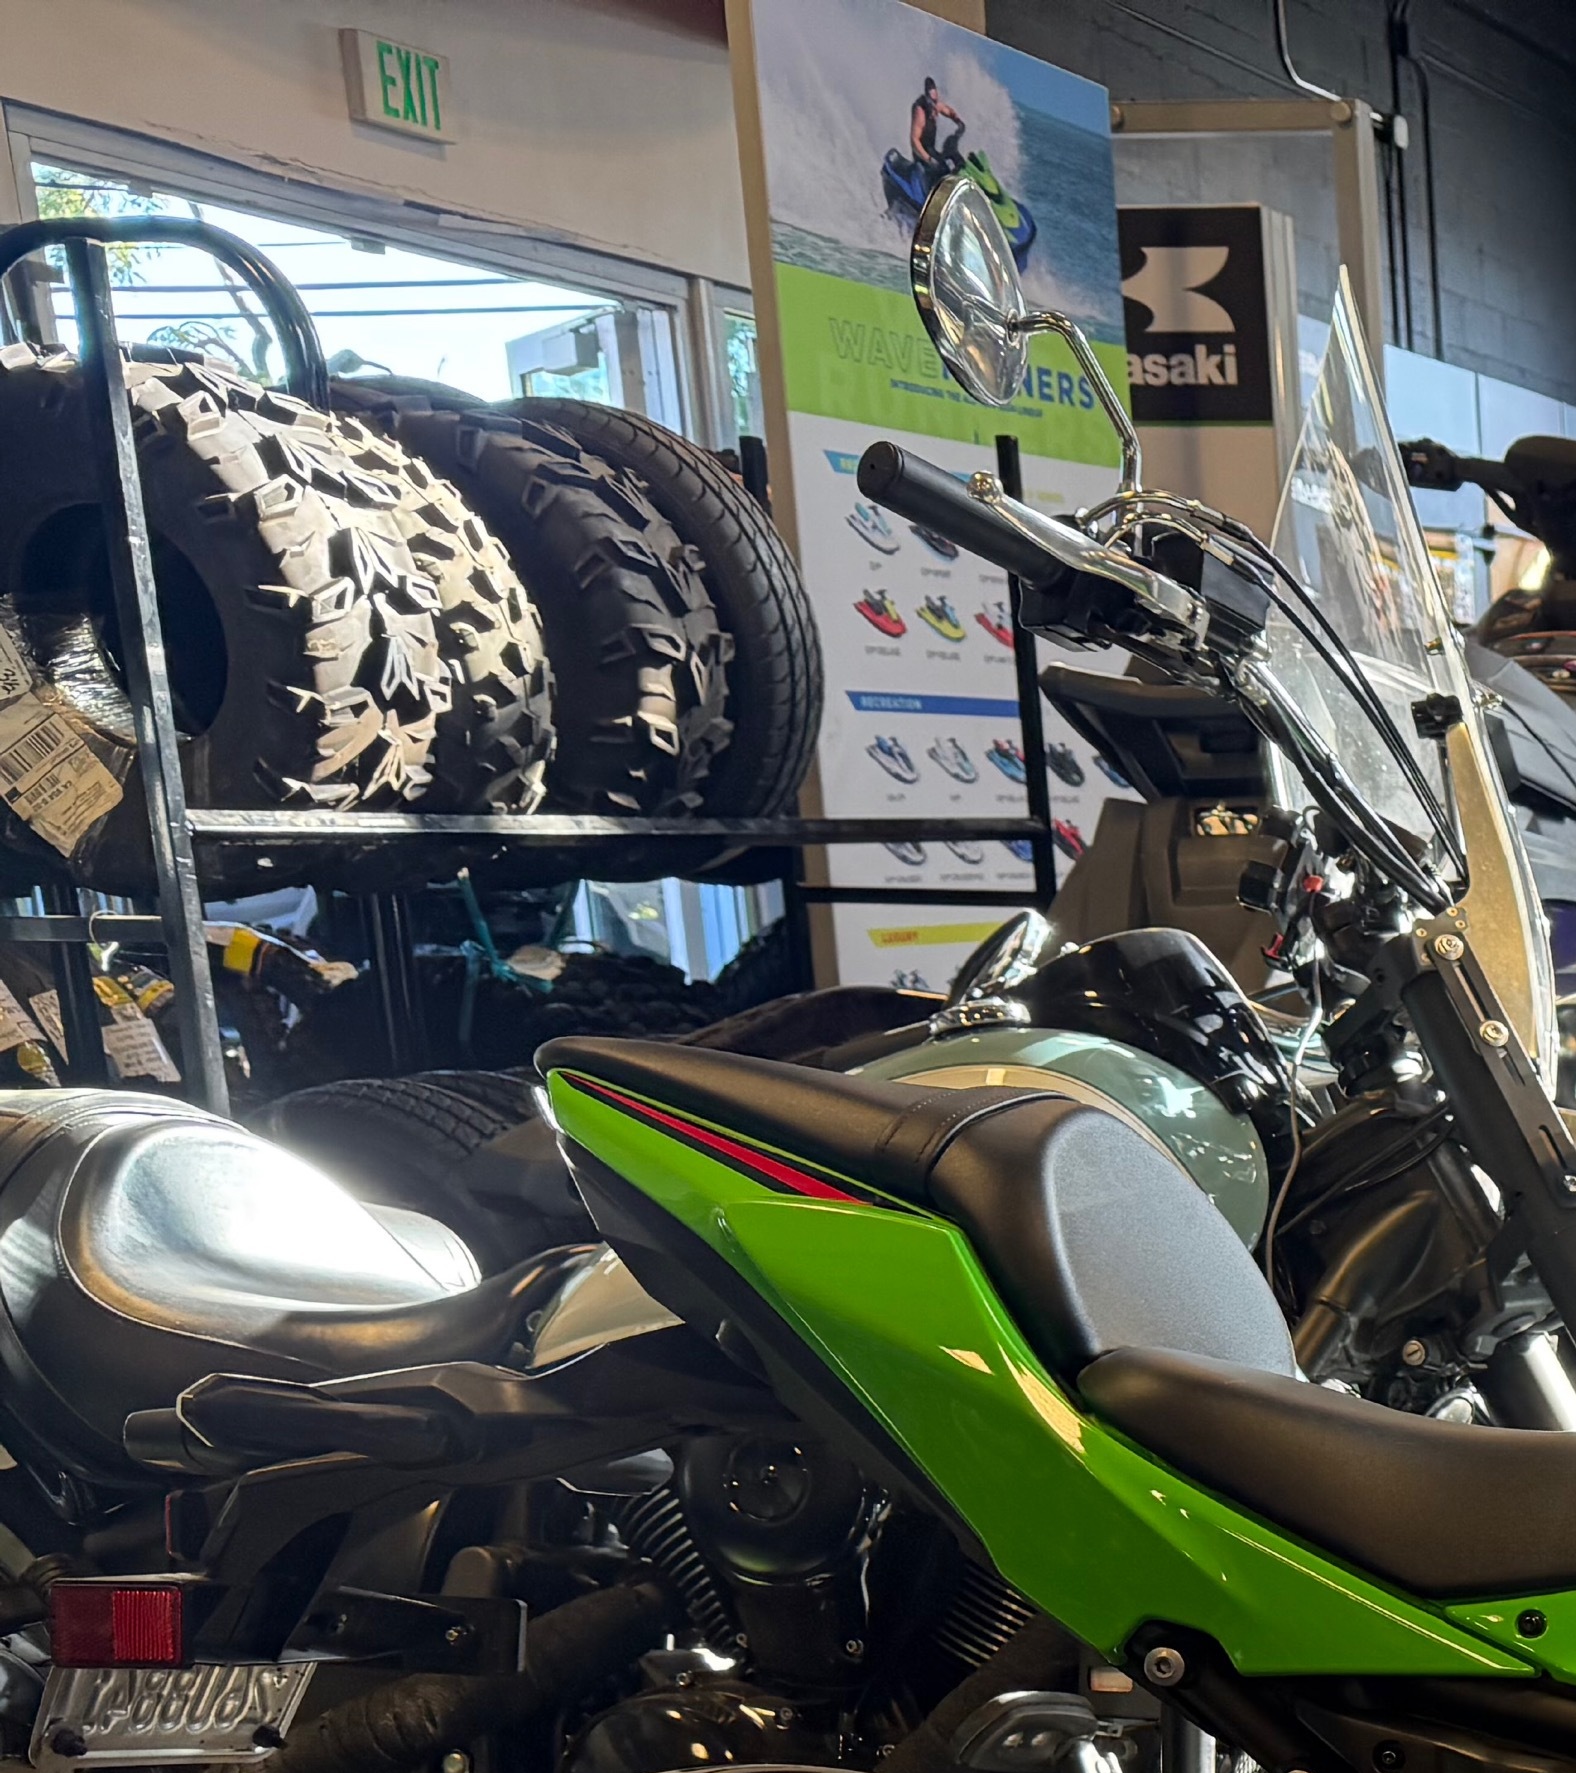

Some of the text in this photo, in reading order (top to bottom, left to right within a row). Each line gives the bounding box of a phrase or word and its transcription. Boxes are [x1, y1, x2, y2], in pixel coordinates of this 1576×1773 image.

[376, 40, 440, 130] EXIT
[829, 318, 1095, 410] WAVENERS
[1126, 343, 1238, 386] asaki
